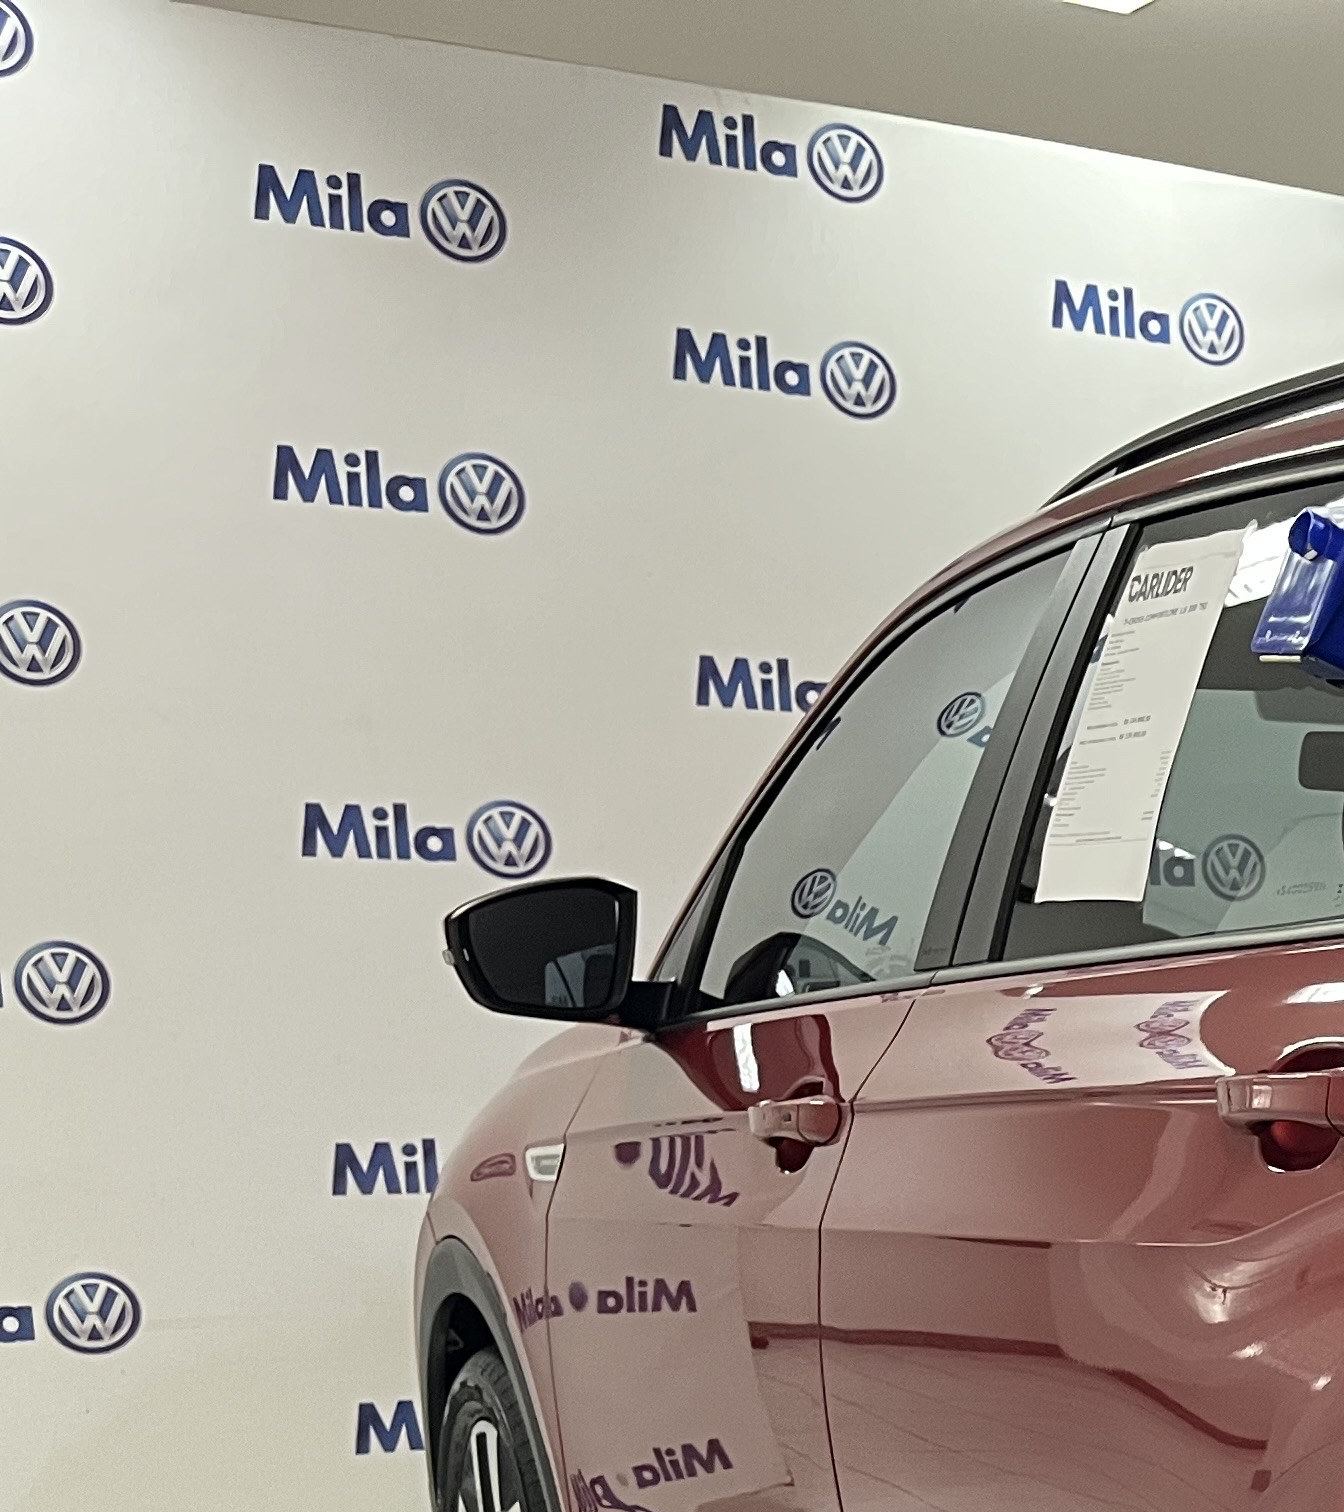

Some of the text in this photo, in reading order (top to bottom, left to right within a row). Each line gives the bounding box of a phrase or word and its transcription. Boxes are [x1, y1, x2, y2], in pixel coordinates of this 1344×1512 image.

[659, 104, 798, 177] Mila
[253, 164, 410, 238] Mila
[1052, 280, 1170, 344] Mila
[673, 328, 811, 396] Mila
[273, 445, 429, 513] Mila
[1128, 565, 1194, 603] CARLIDER
[302, 803, 456, 861] Mila
[332, 1138, 438, 1196] Mil
